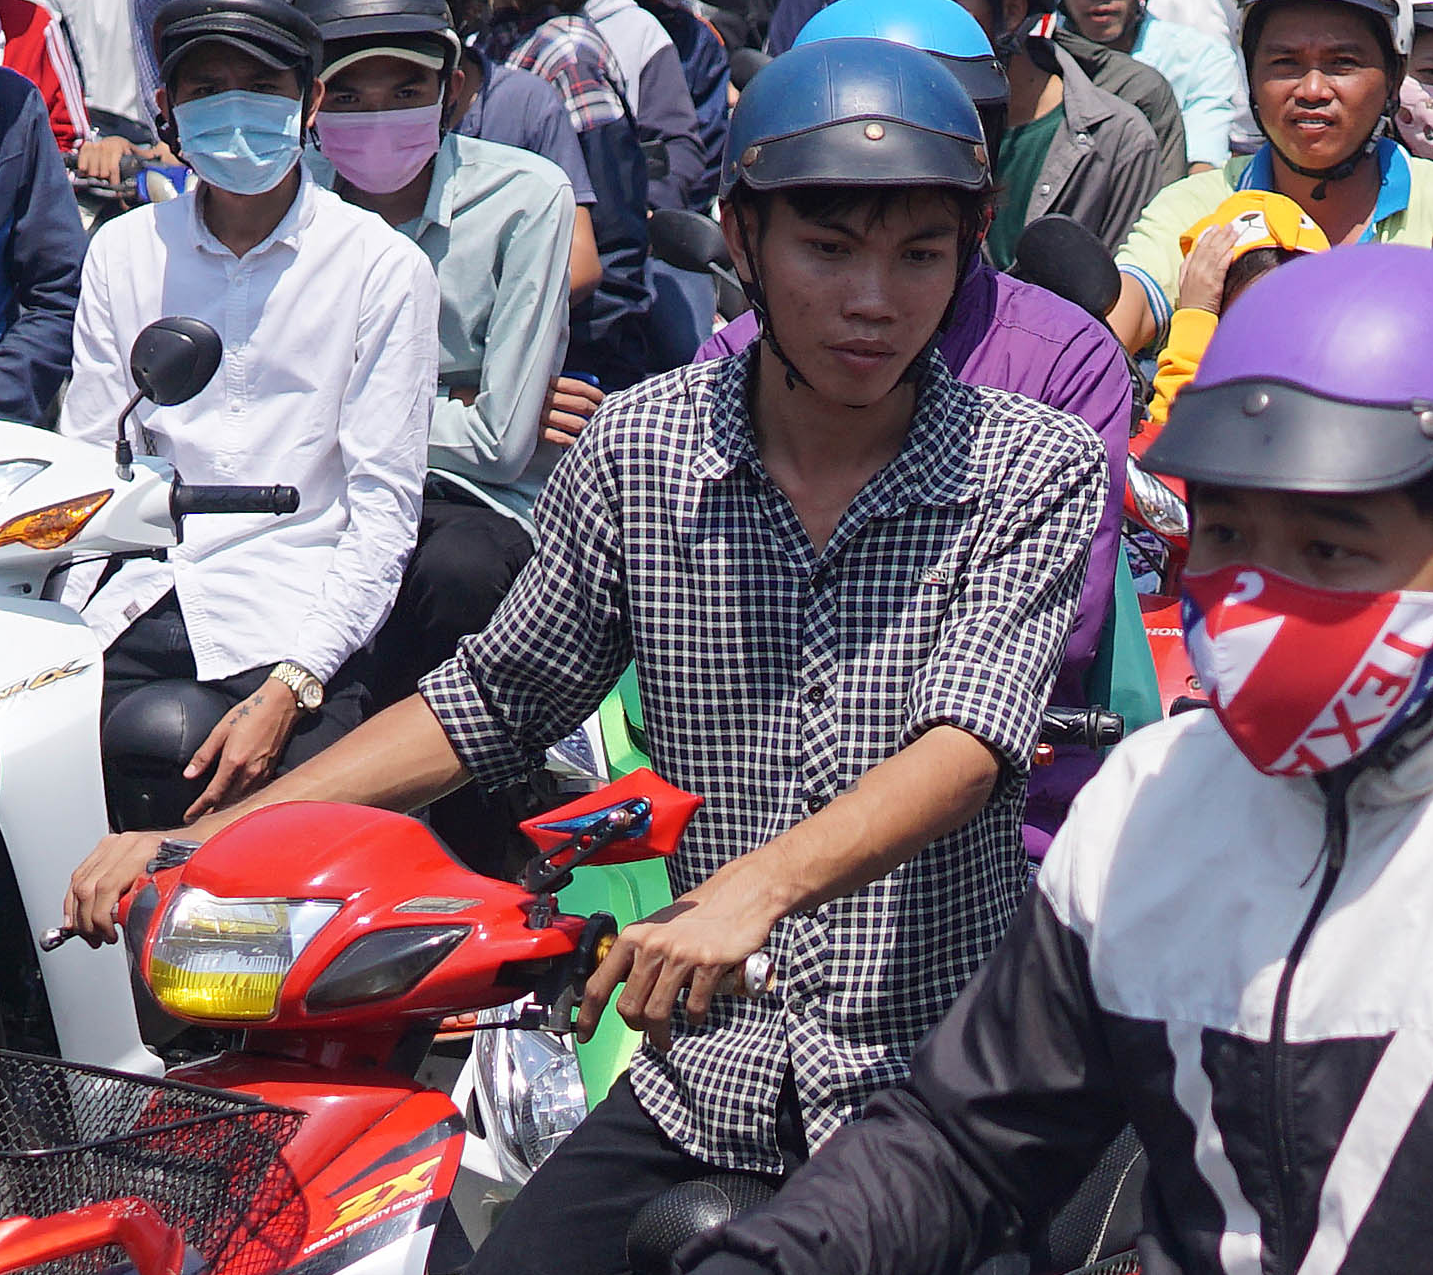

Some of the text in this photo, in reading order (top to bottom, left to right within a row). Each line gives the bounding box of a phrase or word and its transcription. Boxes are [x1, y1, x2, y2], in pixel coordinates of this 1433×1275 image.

[1145, 626, 1184, 638] HON
[303, 1188, 434, 1255] URBAN SPORTY MOVER
[324, 1155, 443, 1234] ZX
